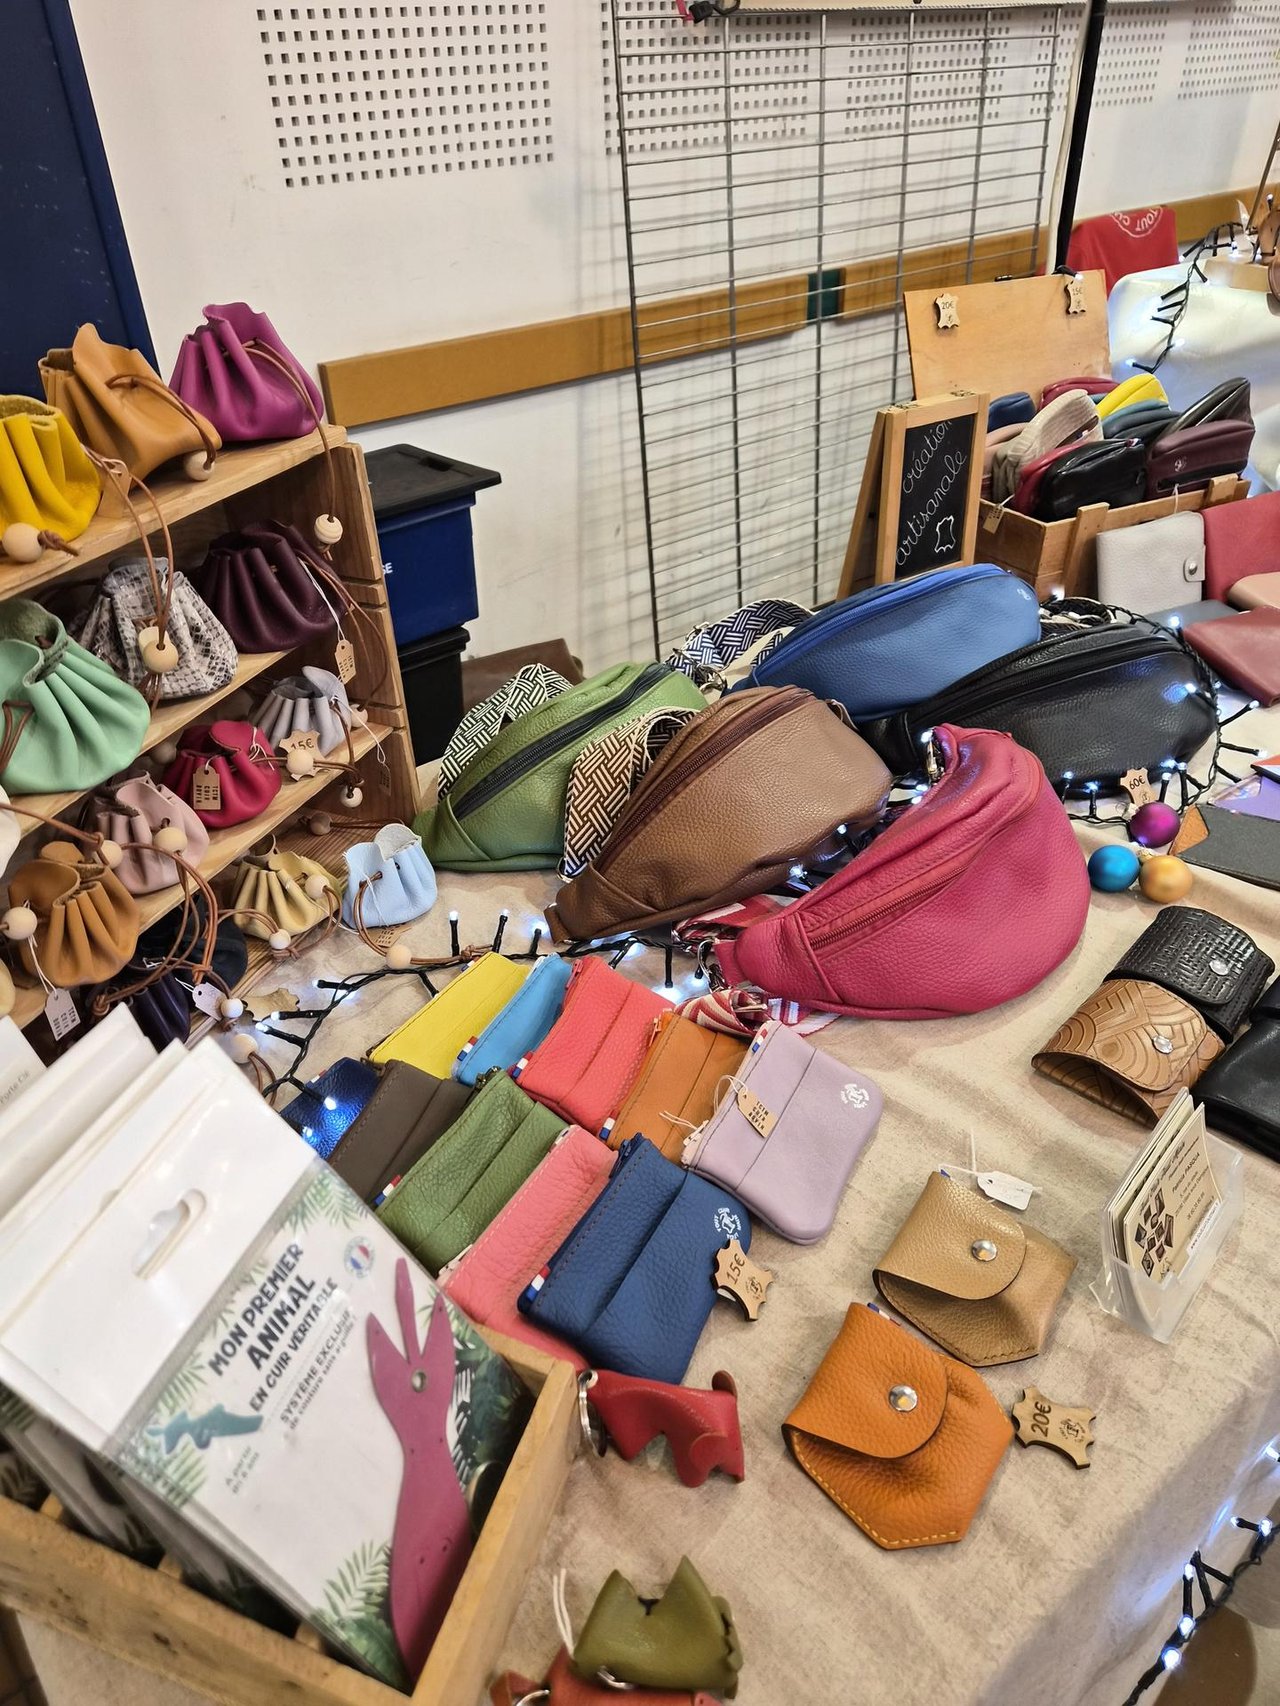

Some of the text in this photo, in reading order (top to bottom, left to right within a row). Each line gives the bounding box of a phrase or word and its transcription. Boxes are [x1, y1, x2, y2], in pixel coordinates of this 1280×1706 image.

[896, 450, 968, 566] artisanale
[1129, 775, 1146, 790] 60€
[726, 1252, 746, 1286] 15€
[208, 1243, 304, 1377] MON PREMIER
[246, 1275, 316, 1371] ANIMAL
[249, 1386, 269, 1413] EN
[265, 1350, 292, 1389] CUIR
[1030, 1401, 1052, 1438] 20€
